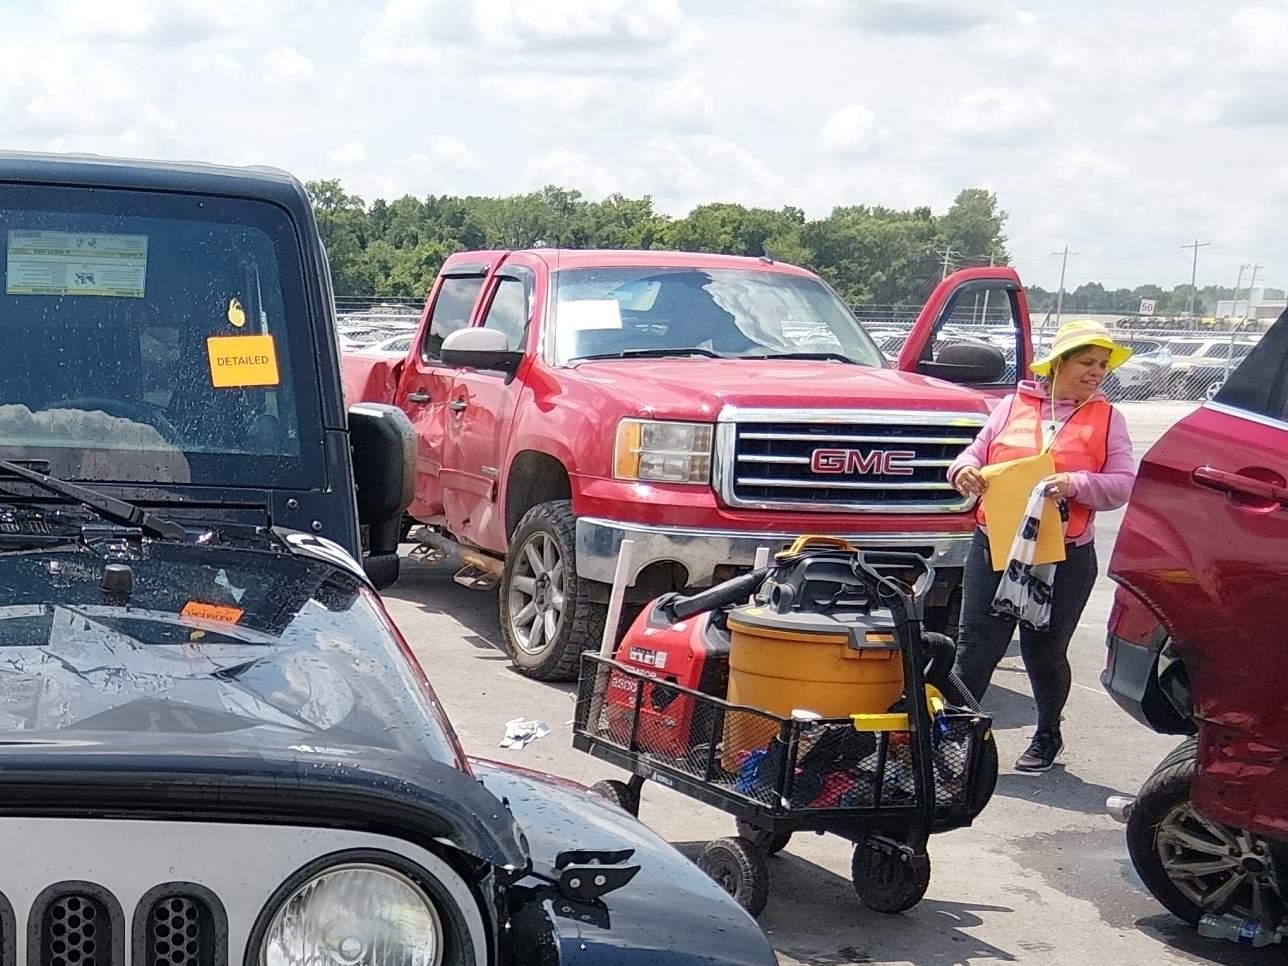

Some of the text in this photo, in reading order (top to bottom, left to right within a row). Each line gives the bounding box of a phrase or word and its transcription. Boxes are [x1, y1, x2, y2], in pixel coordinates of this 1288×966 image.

[1141, 302, 1153, 312] 50
[216, 355, 269, 367] DETAILED
[811, 448, 916, 476] GMC
